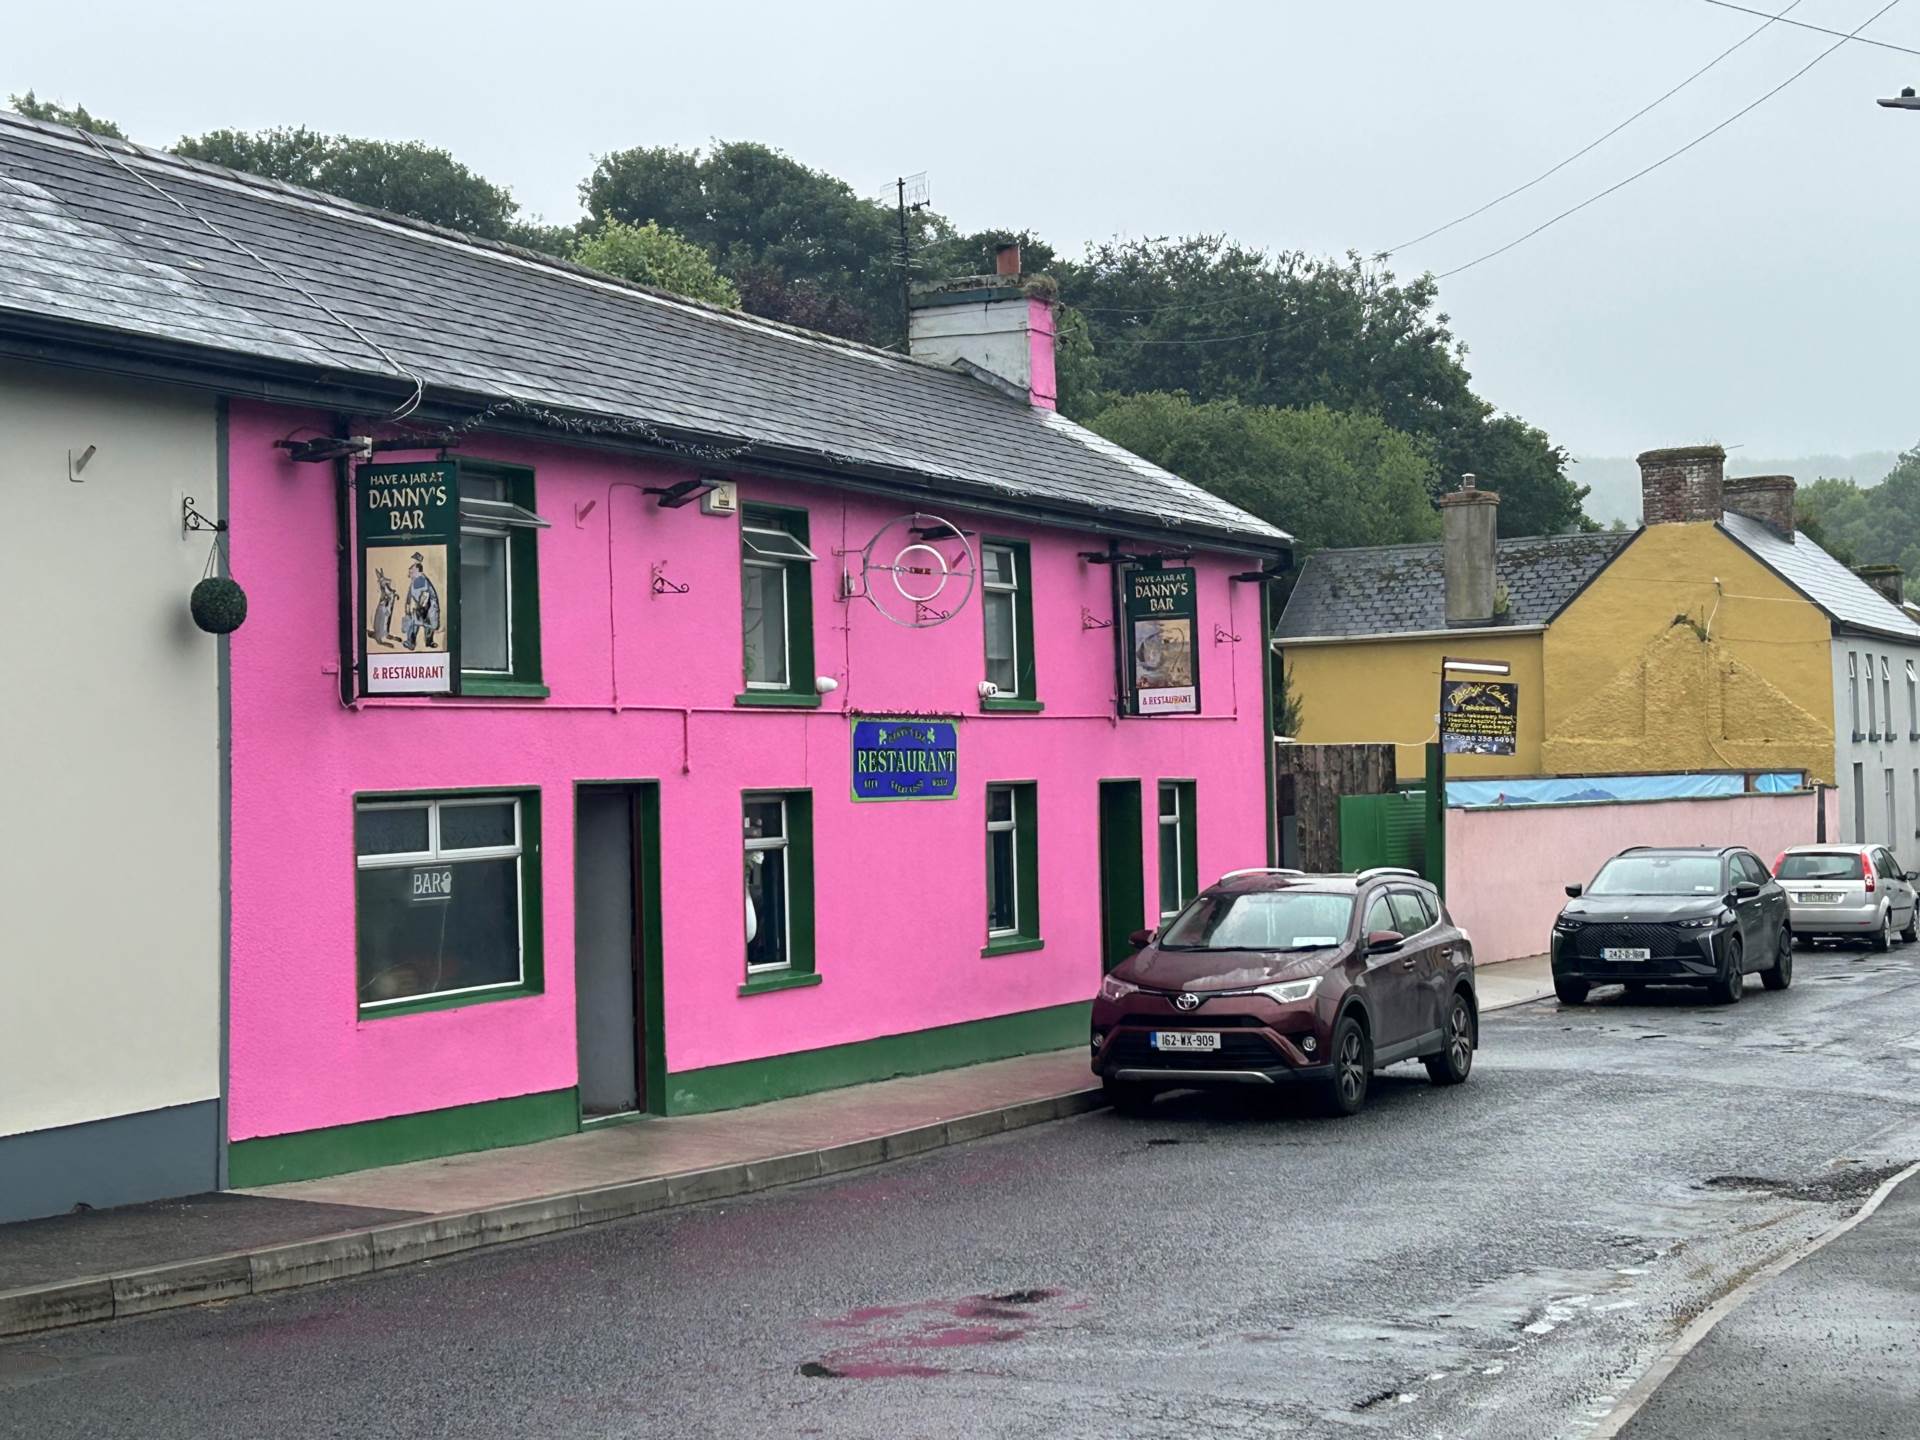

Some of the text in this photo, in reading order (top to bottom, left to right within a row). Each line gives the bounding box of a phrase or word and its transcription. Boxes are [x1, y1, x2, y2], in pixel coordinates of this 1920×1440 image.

[370, 471, 445, 486] HAVE A JAR AT
[368, 486, 448, 509] DANNY'S
[389, 509, 425, 530] BAR
[1135, 582, 1189, 598] DANNY'S
[1150, 598, 1174, 611] BAR
[372, 665, 445, 680] & RESTAURANT
[1148, 694, 1192, 705] RESTAURANT
[858, 750, 956, 773] RESTAURANT
[413, 872, 441, 894] BAR
[1161, 1034, 1215, 1047] 162-WX-909
